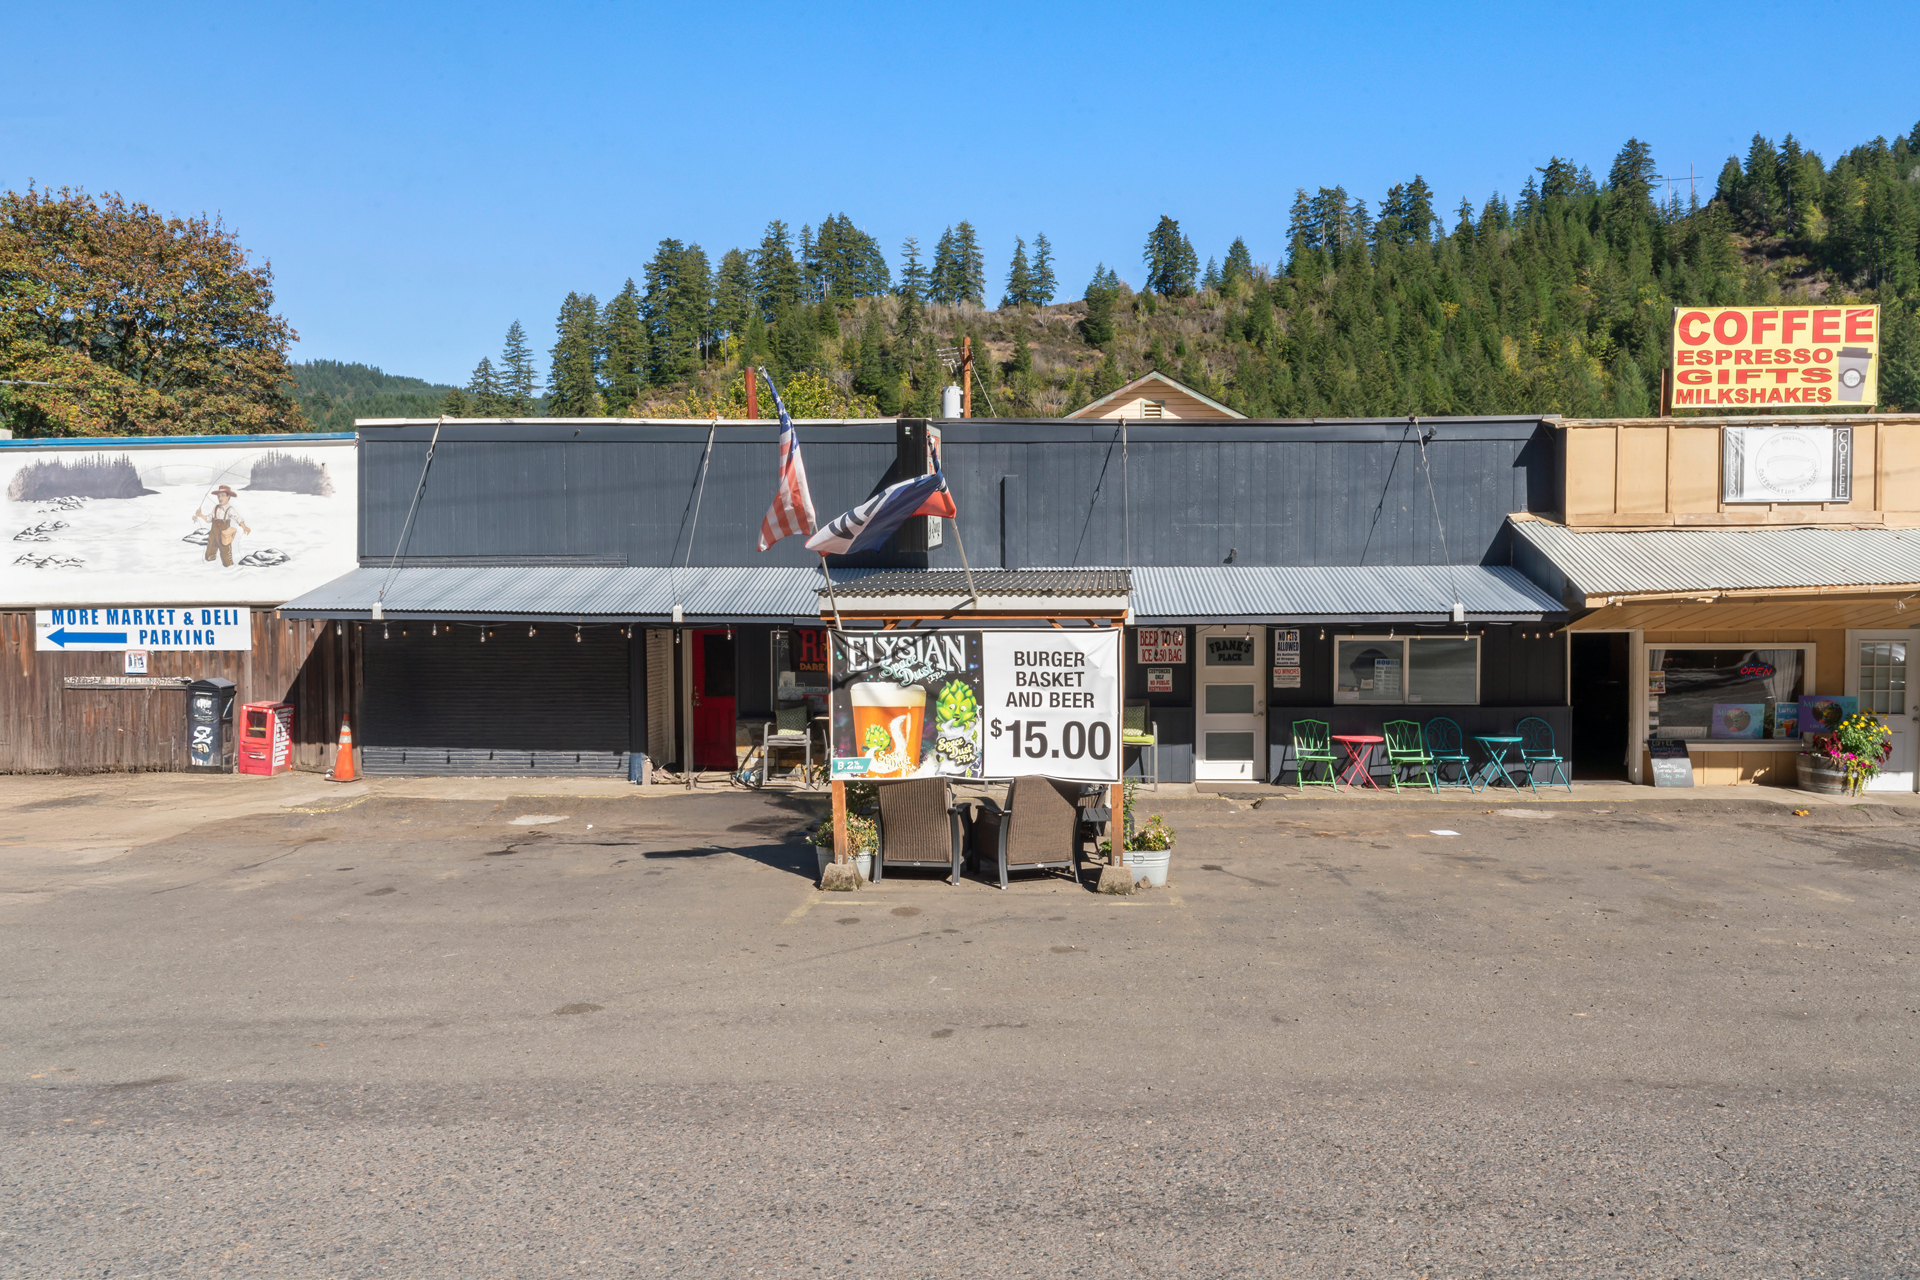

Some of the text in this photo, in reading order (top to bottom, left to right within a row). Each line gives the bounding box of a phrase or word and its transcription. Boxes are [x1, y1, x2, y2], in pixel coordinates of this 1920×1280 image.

[1678, 309, 1875, 346] COFFEE
[1677, 348, 1833, 365] ESPRESSO
[1677, 367, 1833, 385] GIFTS
[1676, 387, 1832, 404] MILKSHAKES
[1838, 431, 1848, 496] COFFEE
[51, 609, 239, 626] MORE MARKET & DELI
[139, 629, 216, 646] PARKING
[1140, 630, 1184, 647] BEER TO GO
[1278, 631, 1286, 641] NO
[846, 634, 967, 673] ELYSIAN
[1141, 648, 1153, 662] ICE
[1168, 648, 1182, 662] BAG
[1208, 639, 1252, 654] FRANK'S
[1277, 642, 1299, 652] ALLOWED
[1013, 650, 1085, 667] BURGER
[1218, 653, 1243, 662] PLACE
[799, 662, 825, 671] DARE
[880, 655, 919, 678] Space
[900, 661, 934, 686] Dust
[1740, 666, 1773, 676] OPEN
[927, 670, 946, 683] IPA
[1015, 671, 1085, 688] BASKET
[1005, 691, 1095, 708] AND BEER
[937, 737, 964, 753] Space
[990, 717, 1112, 761] $15.00
[949, 744, 973, 758] Dust
[955, 753, 976, 764] IPA
